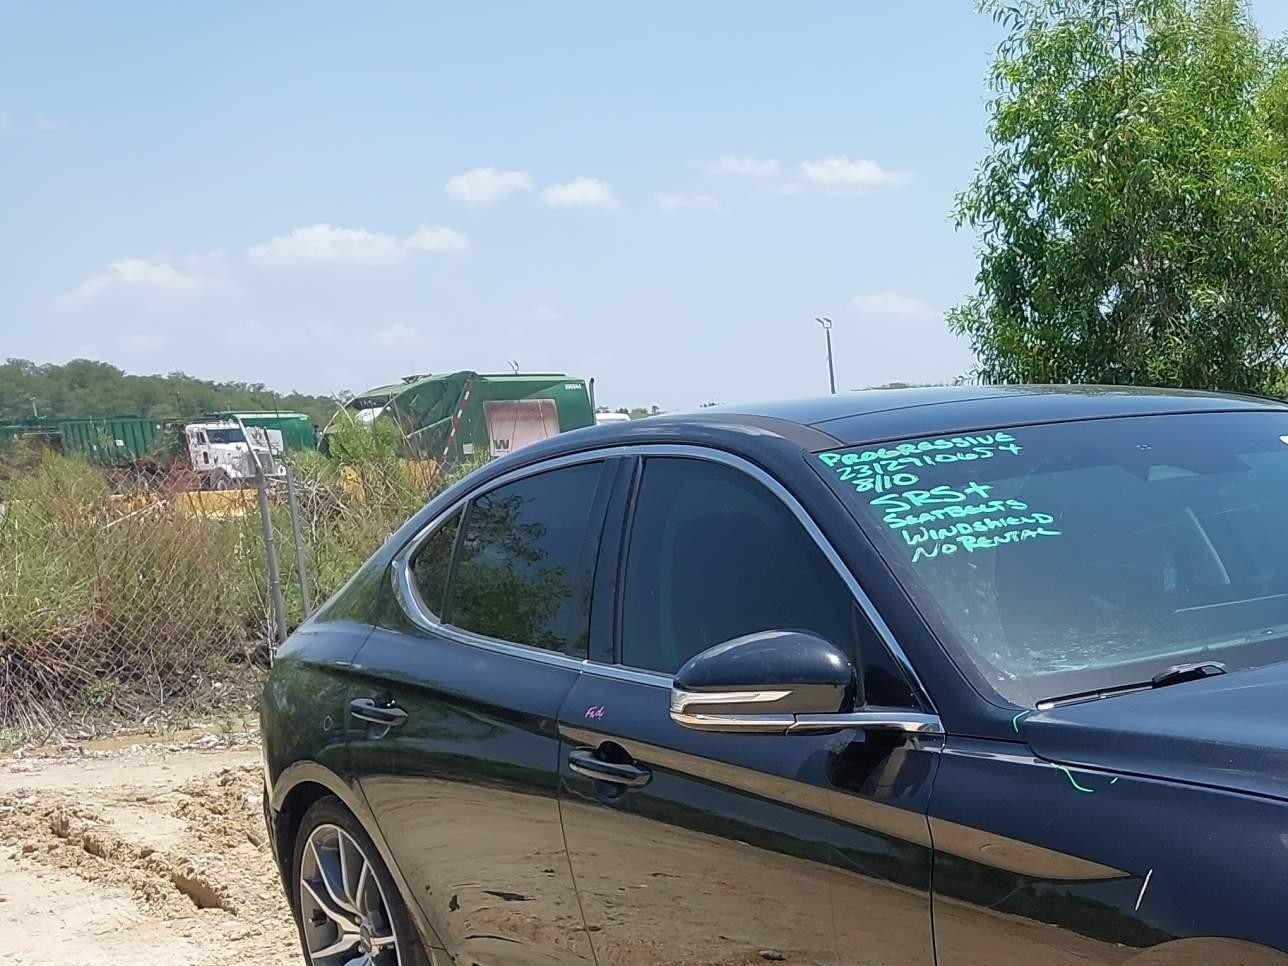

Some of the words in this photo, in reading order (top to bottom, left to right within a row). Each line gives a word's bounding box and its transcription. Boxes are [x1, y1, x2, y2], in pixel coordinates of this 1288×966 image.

[818, 431, 1017, 467] PROGRESSIVE
[882, 499, 1028, 529] SEATBELTS
[911, 541, 959, 564] NO
[956, 527, 1063, 553] RENTAL
